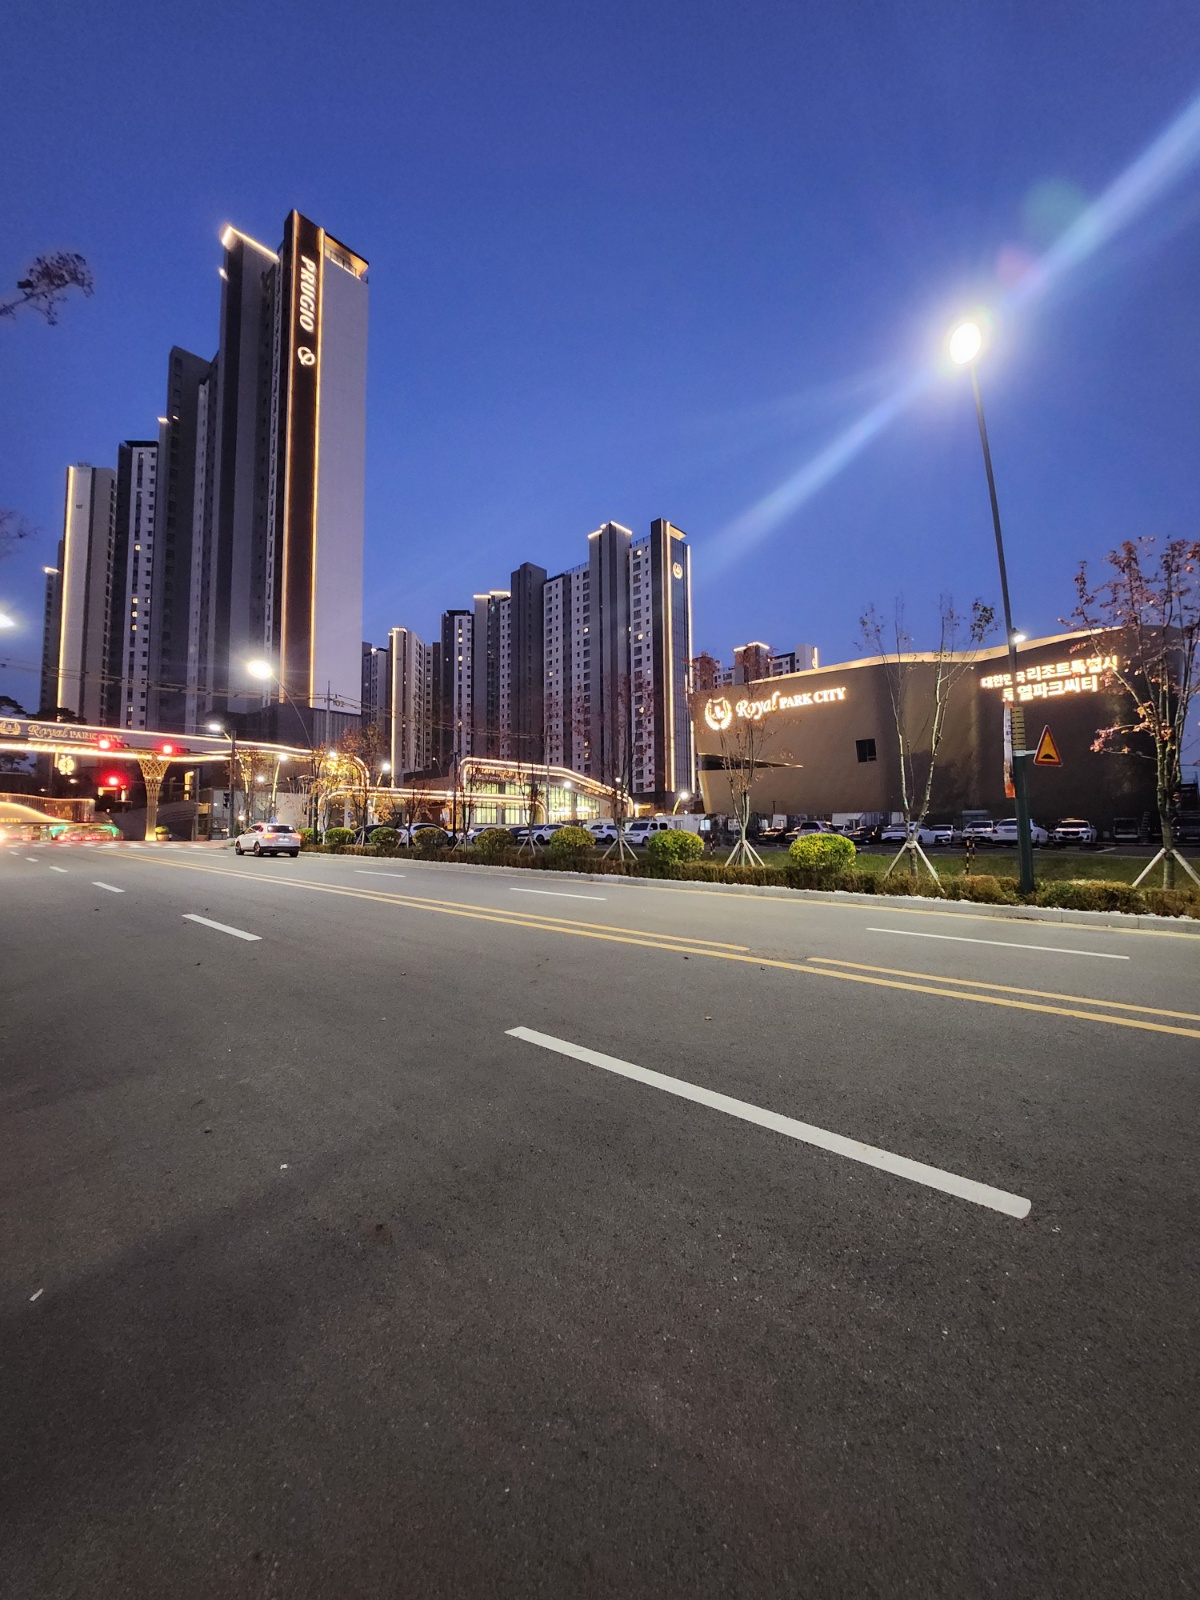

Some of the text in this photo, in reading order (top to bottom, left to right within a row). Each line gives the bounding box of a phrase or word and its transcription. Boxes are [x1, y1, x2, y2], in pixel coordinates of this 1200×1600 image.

[300, 255, 318, 333] PRUGIO
[736, 687, 847, 720] Royal PARK CITY
[28, 724, 72, 739] Royal
[69, 731, 98, 741] PARK
